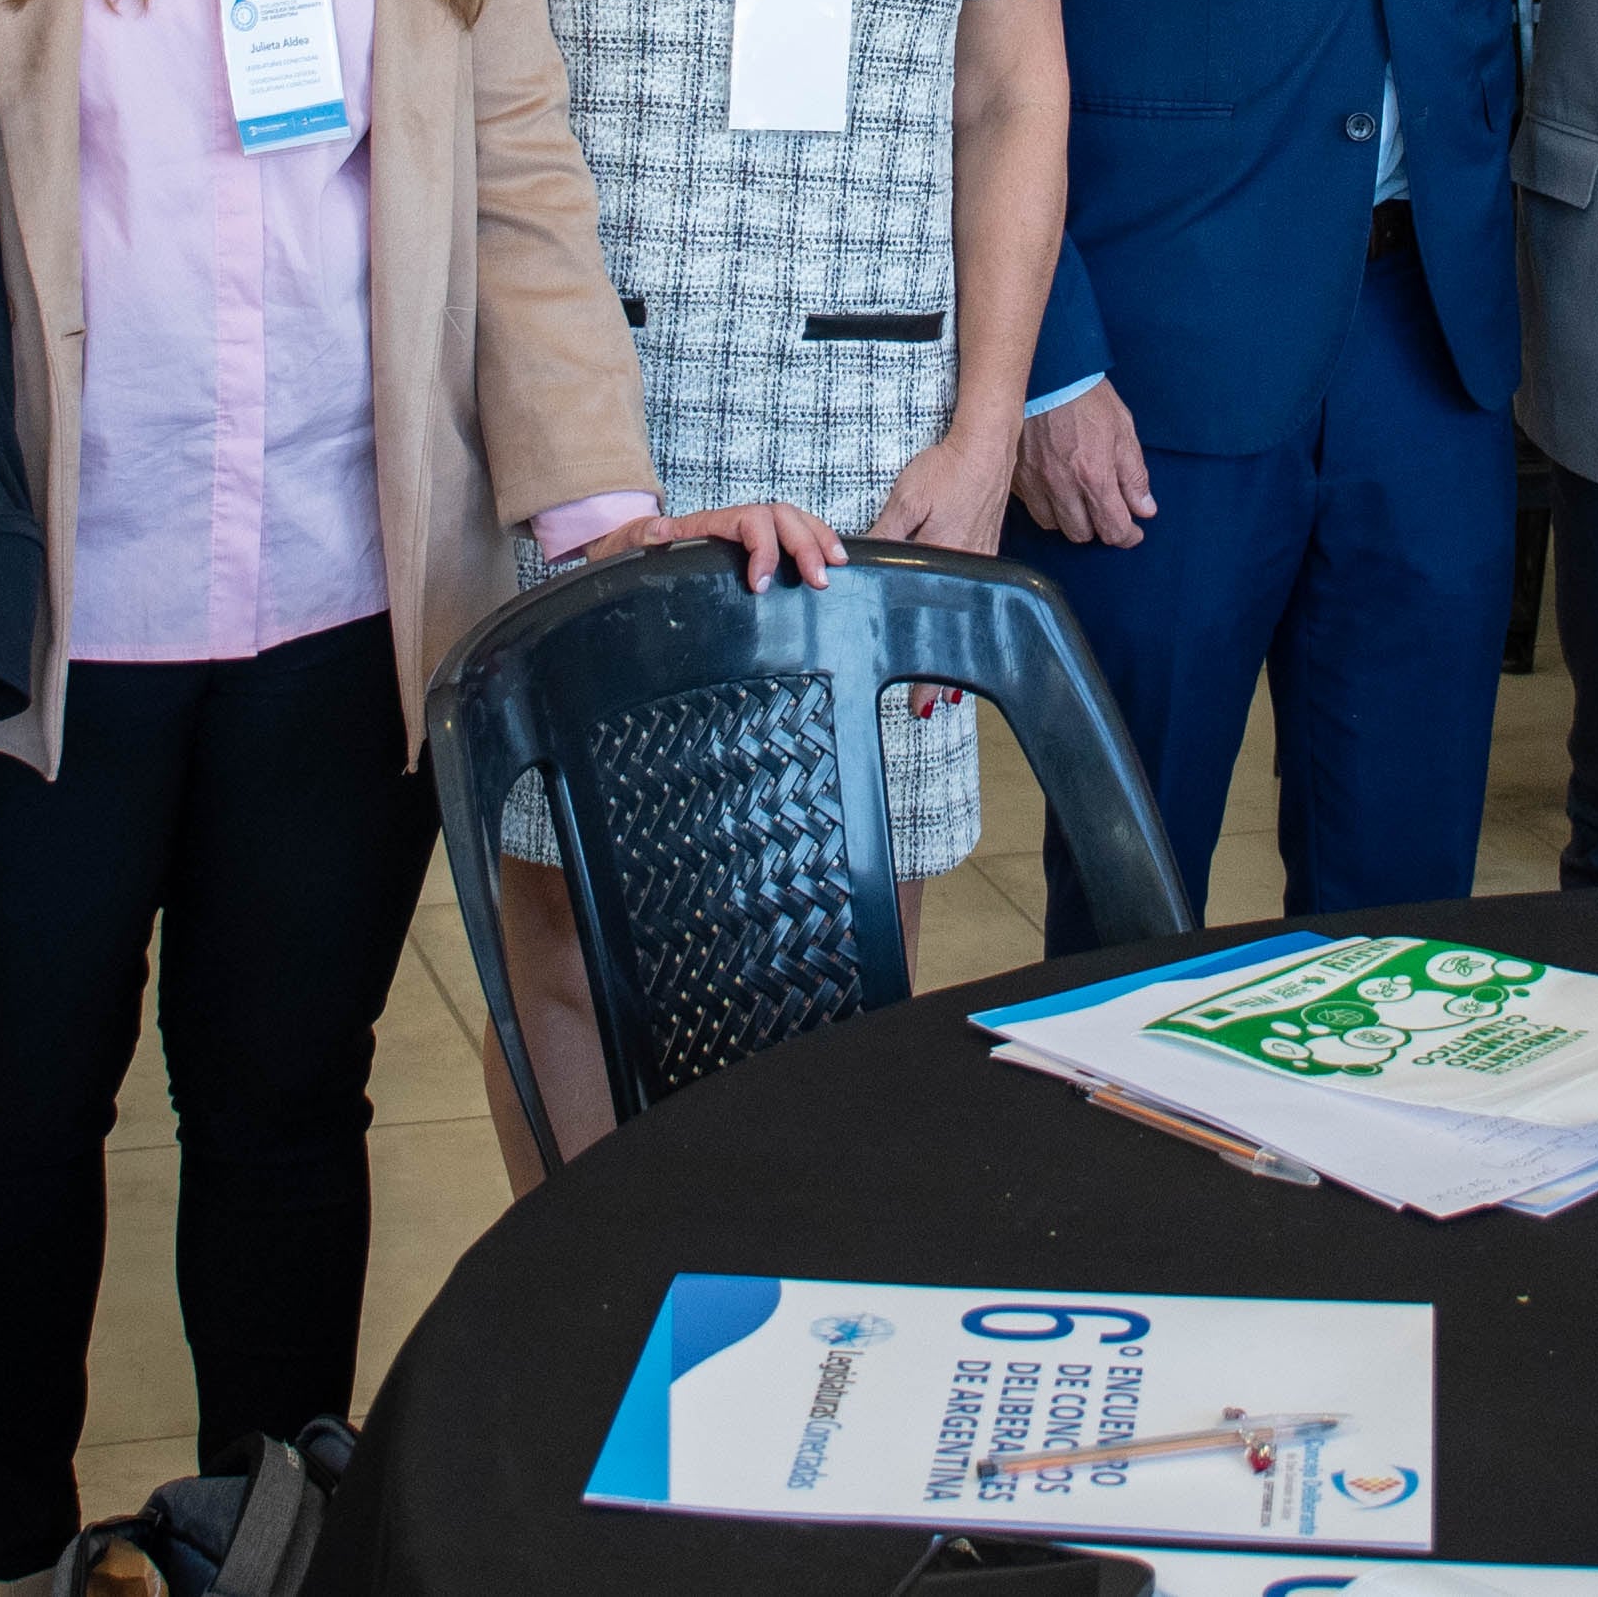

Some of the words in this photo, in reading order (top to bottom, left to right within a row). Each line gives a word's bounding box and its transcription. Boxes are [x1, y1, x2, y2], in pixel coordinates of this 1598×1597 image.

[251, 41, 281, 53] Julieta
[283, 36, 309, 48] Aldea
[1446, 1028, 1530, 1067] CAMBIO
[1467, 1026, 1568, 1073] AMBIENTE
[953, 1359, 992, 1384] DE
[1054, 1363, 1093, 1388] DE
[923, 1387, 982, 1502] ARGENTINA
[1035, 1392, 1088, 1495] CONCOS
[1090, 1364, 1143, 1488] ENCUENRO
[1299, 1480, 1323, 1536] Deliberante
